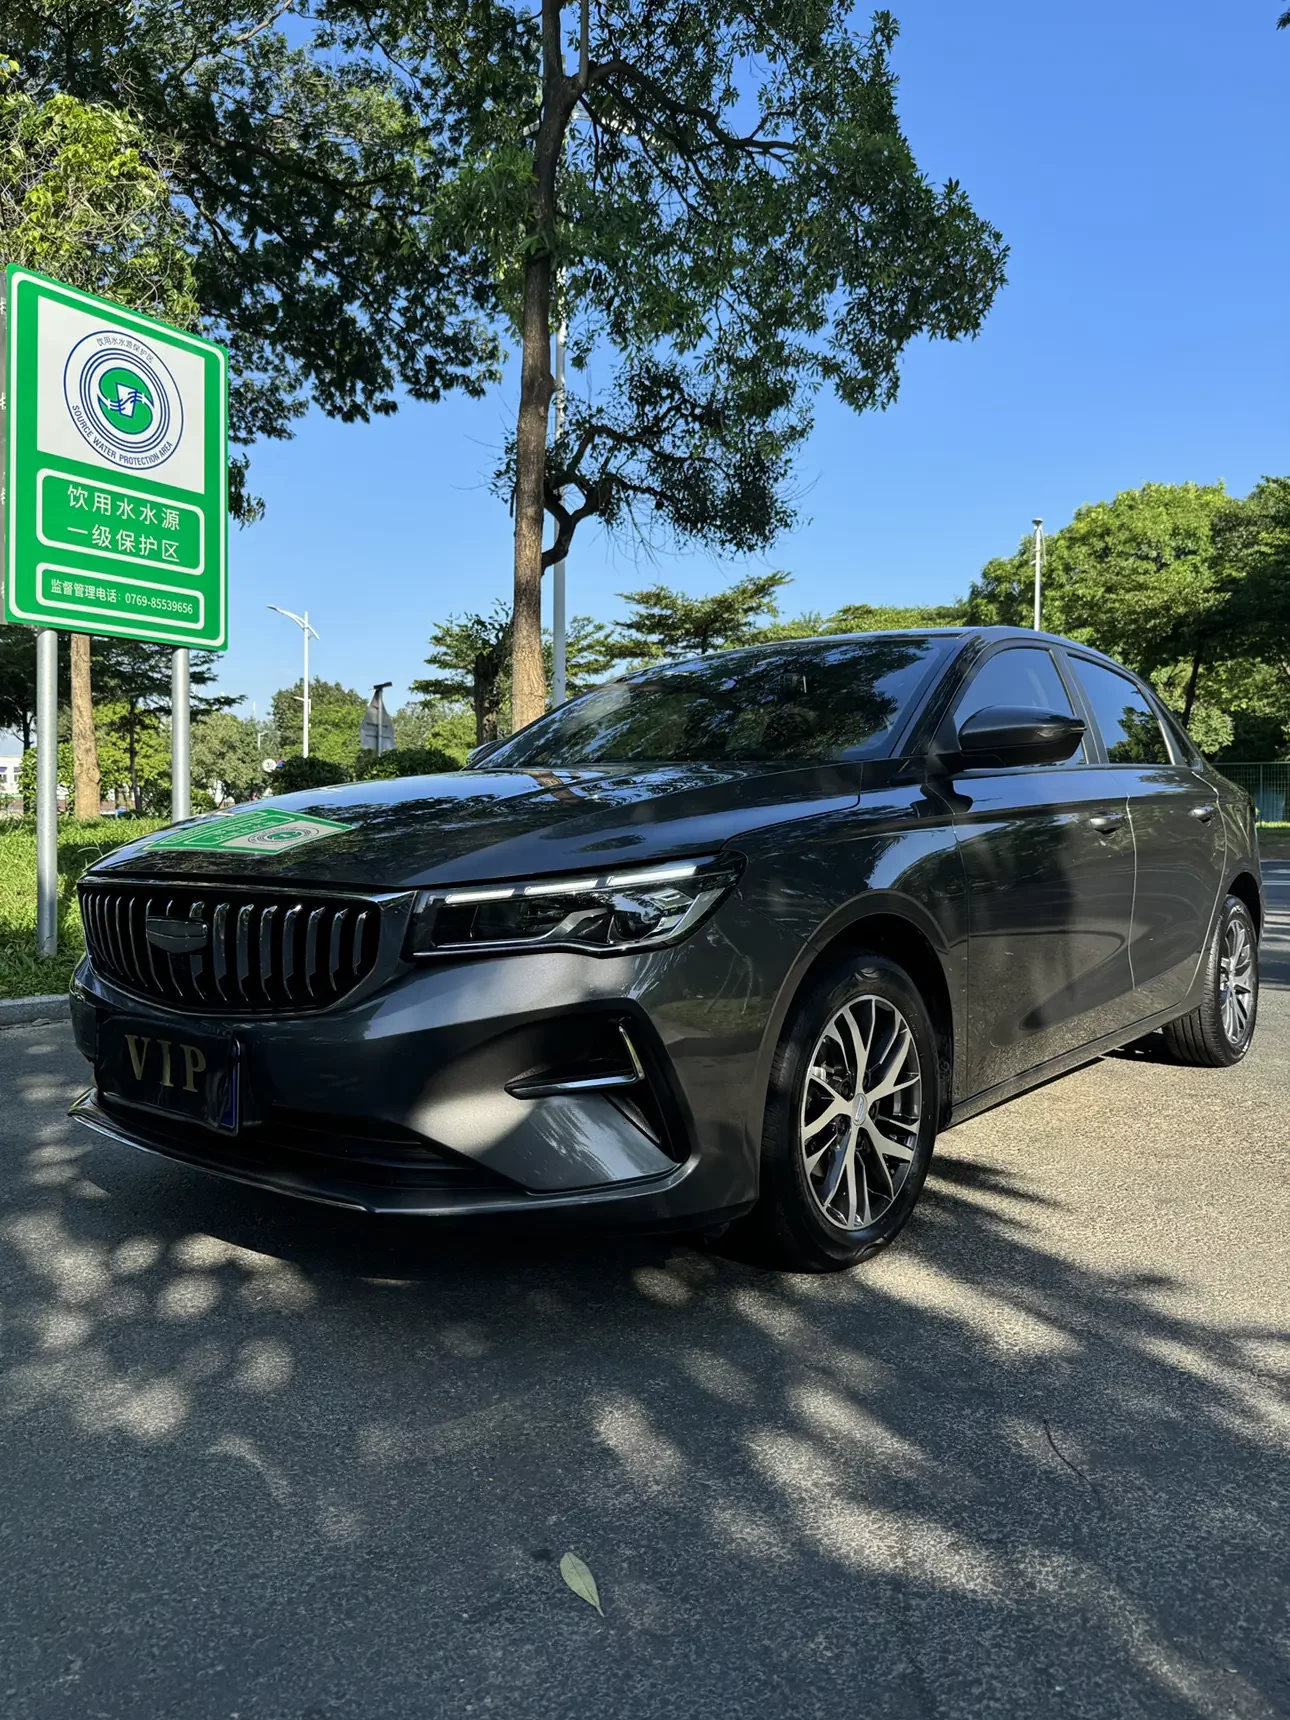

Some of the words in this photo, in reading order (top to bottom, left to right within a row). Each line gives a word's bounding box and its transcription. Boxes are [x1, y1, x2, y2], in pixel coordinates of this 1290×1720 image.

[72, 405, 94, 437] SOURCE
[93, 436, 117, 459] WATER
[119, 453, 160, 466] PROTECTION
[158, 441, 173, 456] AREA
[67, 484, 180, 531] 饮用水水源
[67, 523, 180, 562] 一级保护区
[124, 1034, 207, 1092] VIP
